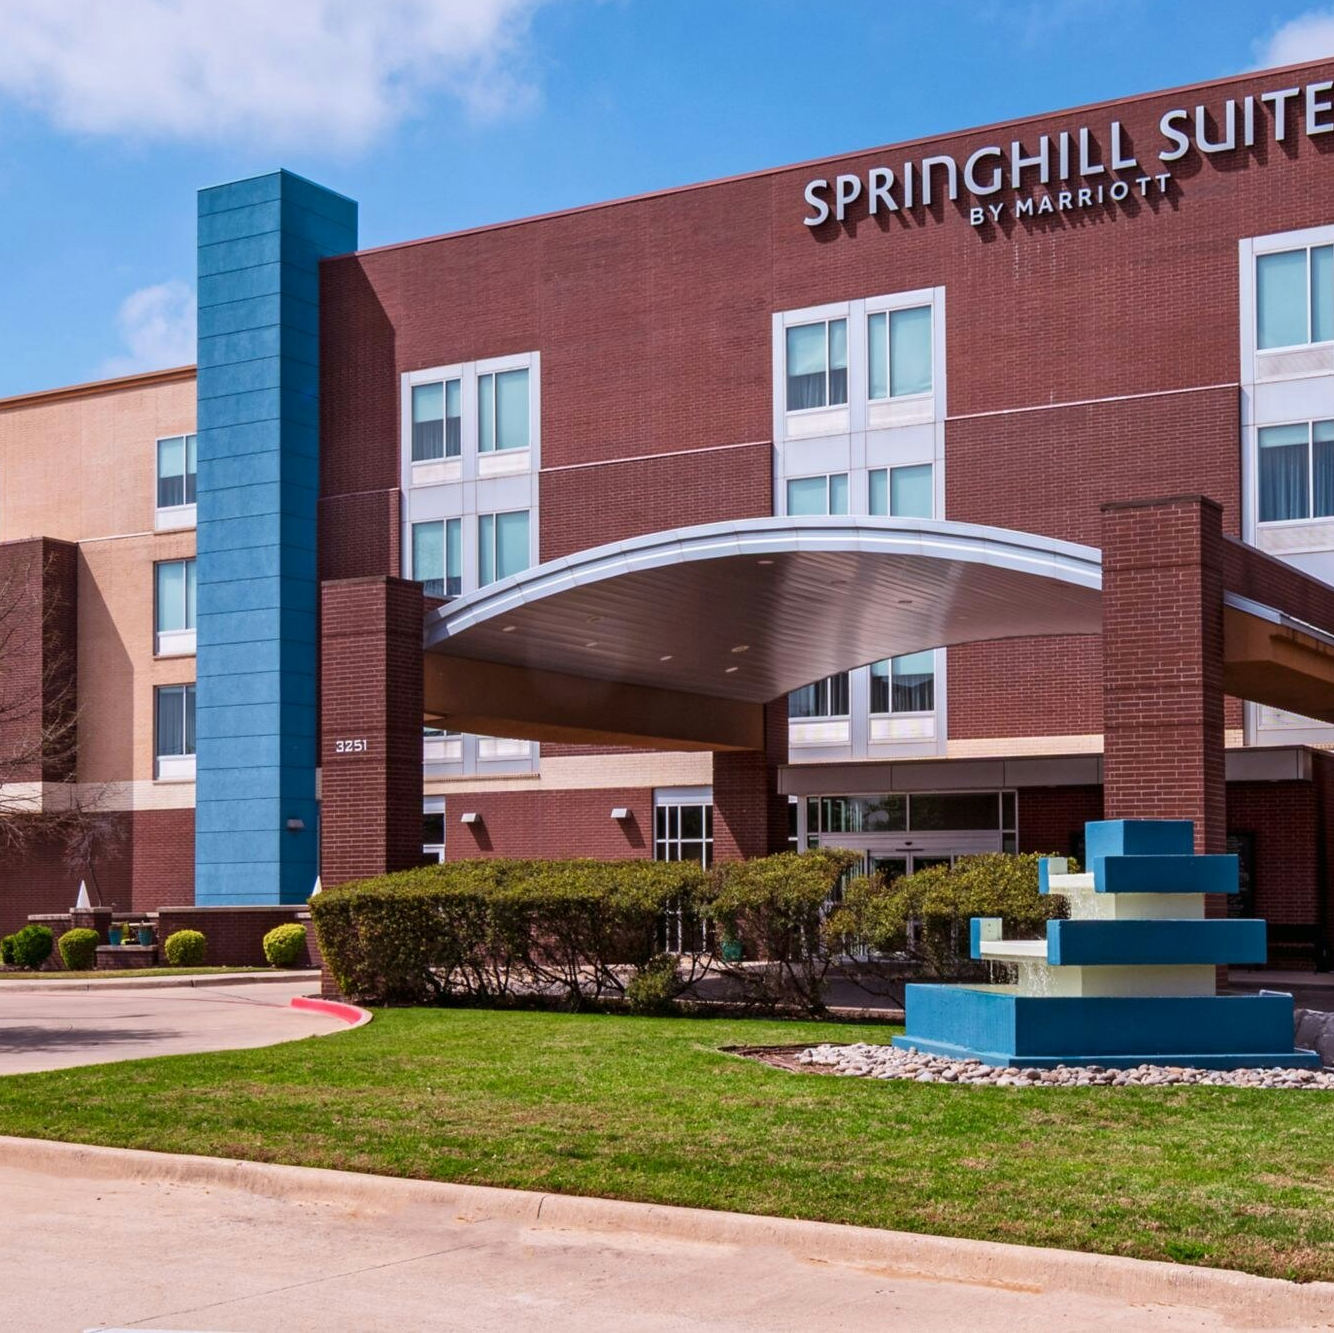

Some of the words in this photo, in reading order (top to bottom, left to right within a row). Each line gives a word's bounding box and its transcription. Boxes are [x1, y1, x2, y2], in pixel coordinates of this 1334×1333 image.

[803, 121, 1138, 226] SPRINGHILL
[969, 203, 1004, 226] BY
[1015, 173, 1171, 219] MARRIOTT
[336, 739, 367, 753] 3251
